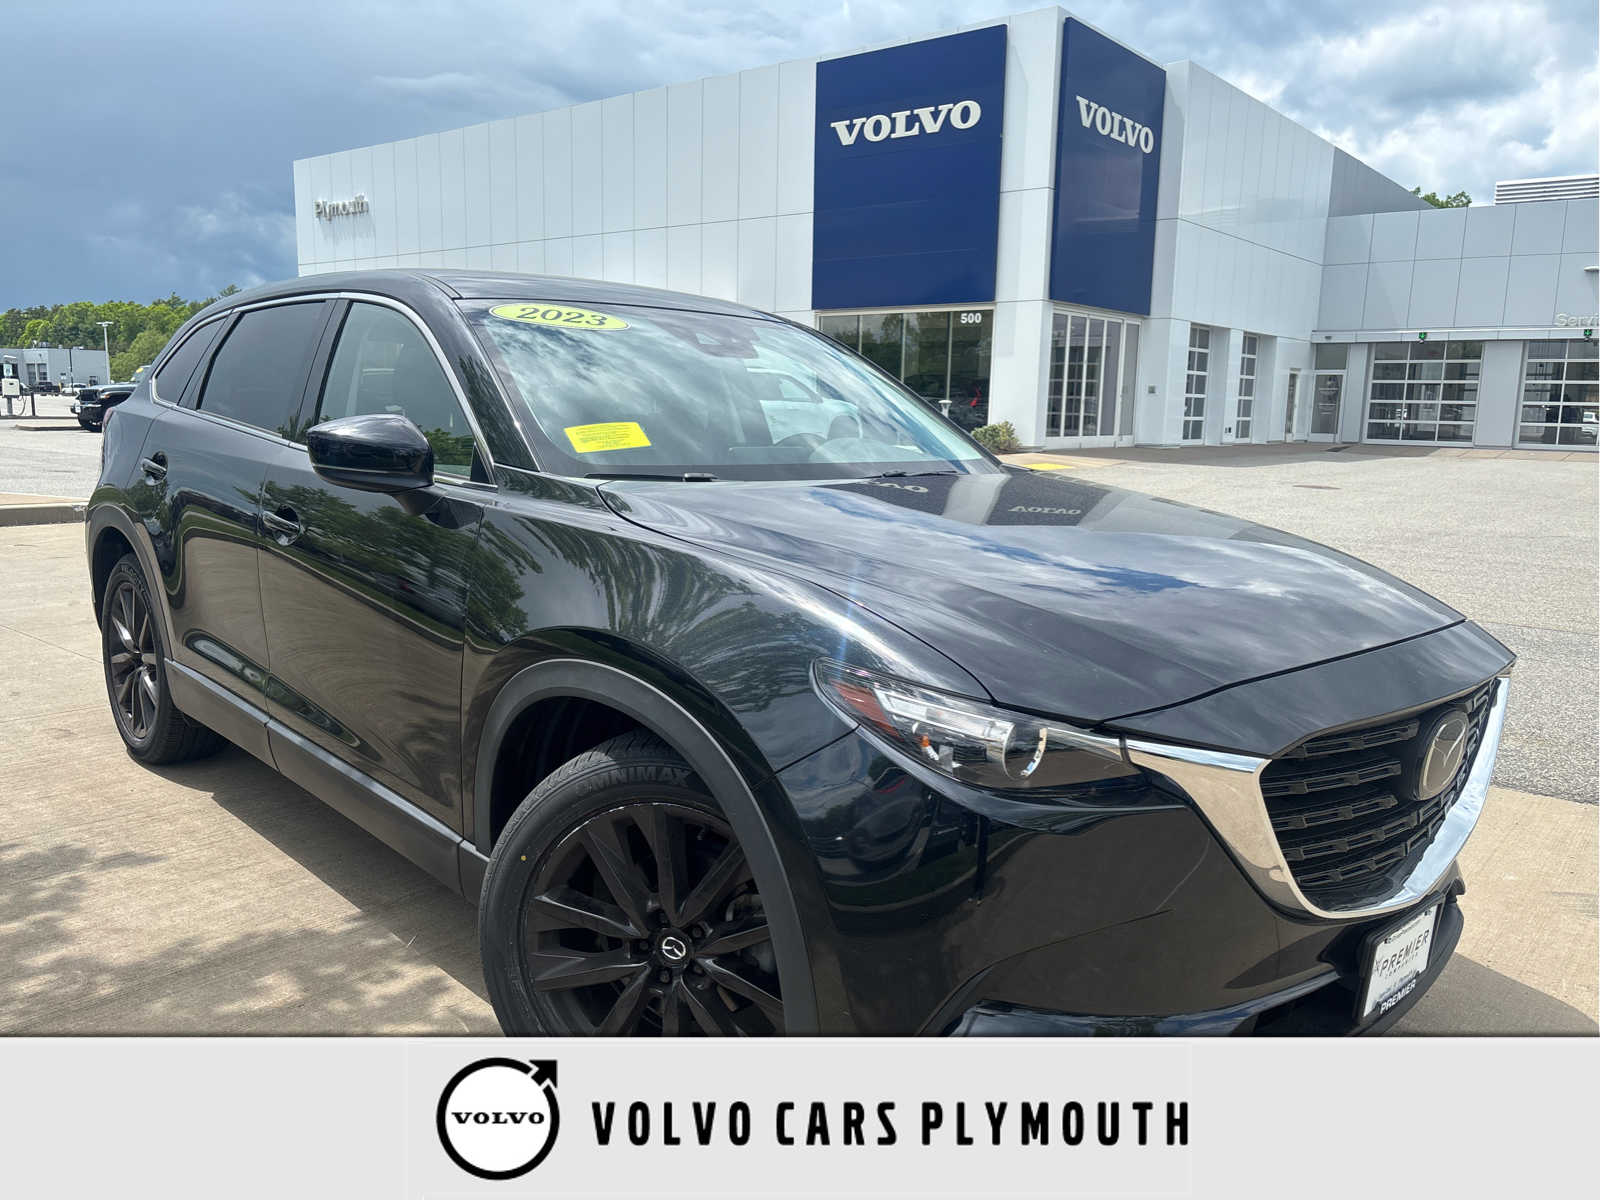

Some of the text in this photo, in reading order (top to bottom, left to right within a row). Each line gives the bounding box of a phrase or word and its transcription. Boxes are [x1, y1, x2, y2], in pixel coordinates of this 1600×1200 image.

[830, 99, 982, 146] VOLVO
[1076, 95, 1154, 154] VOLVO
[314, 194, 369, 222] Plymouth
[516, 307, 608, 326] 2023
[960, 312, 982, 324] 500
[1378, 928, 1430, 977] PREMIER
[1379, 978, 1417, 1015] PREMIER
